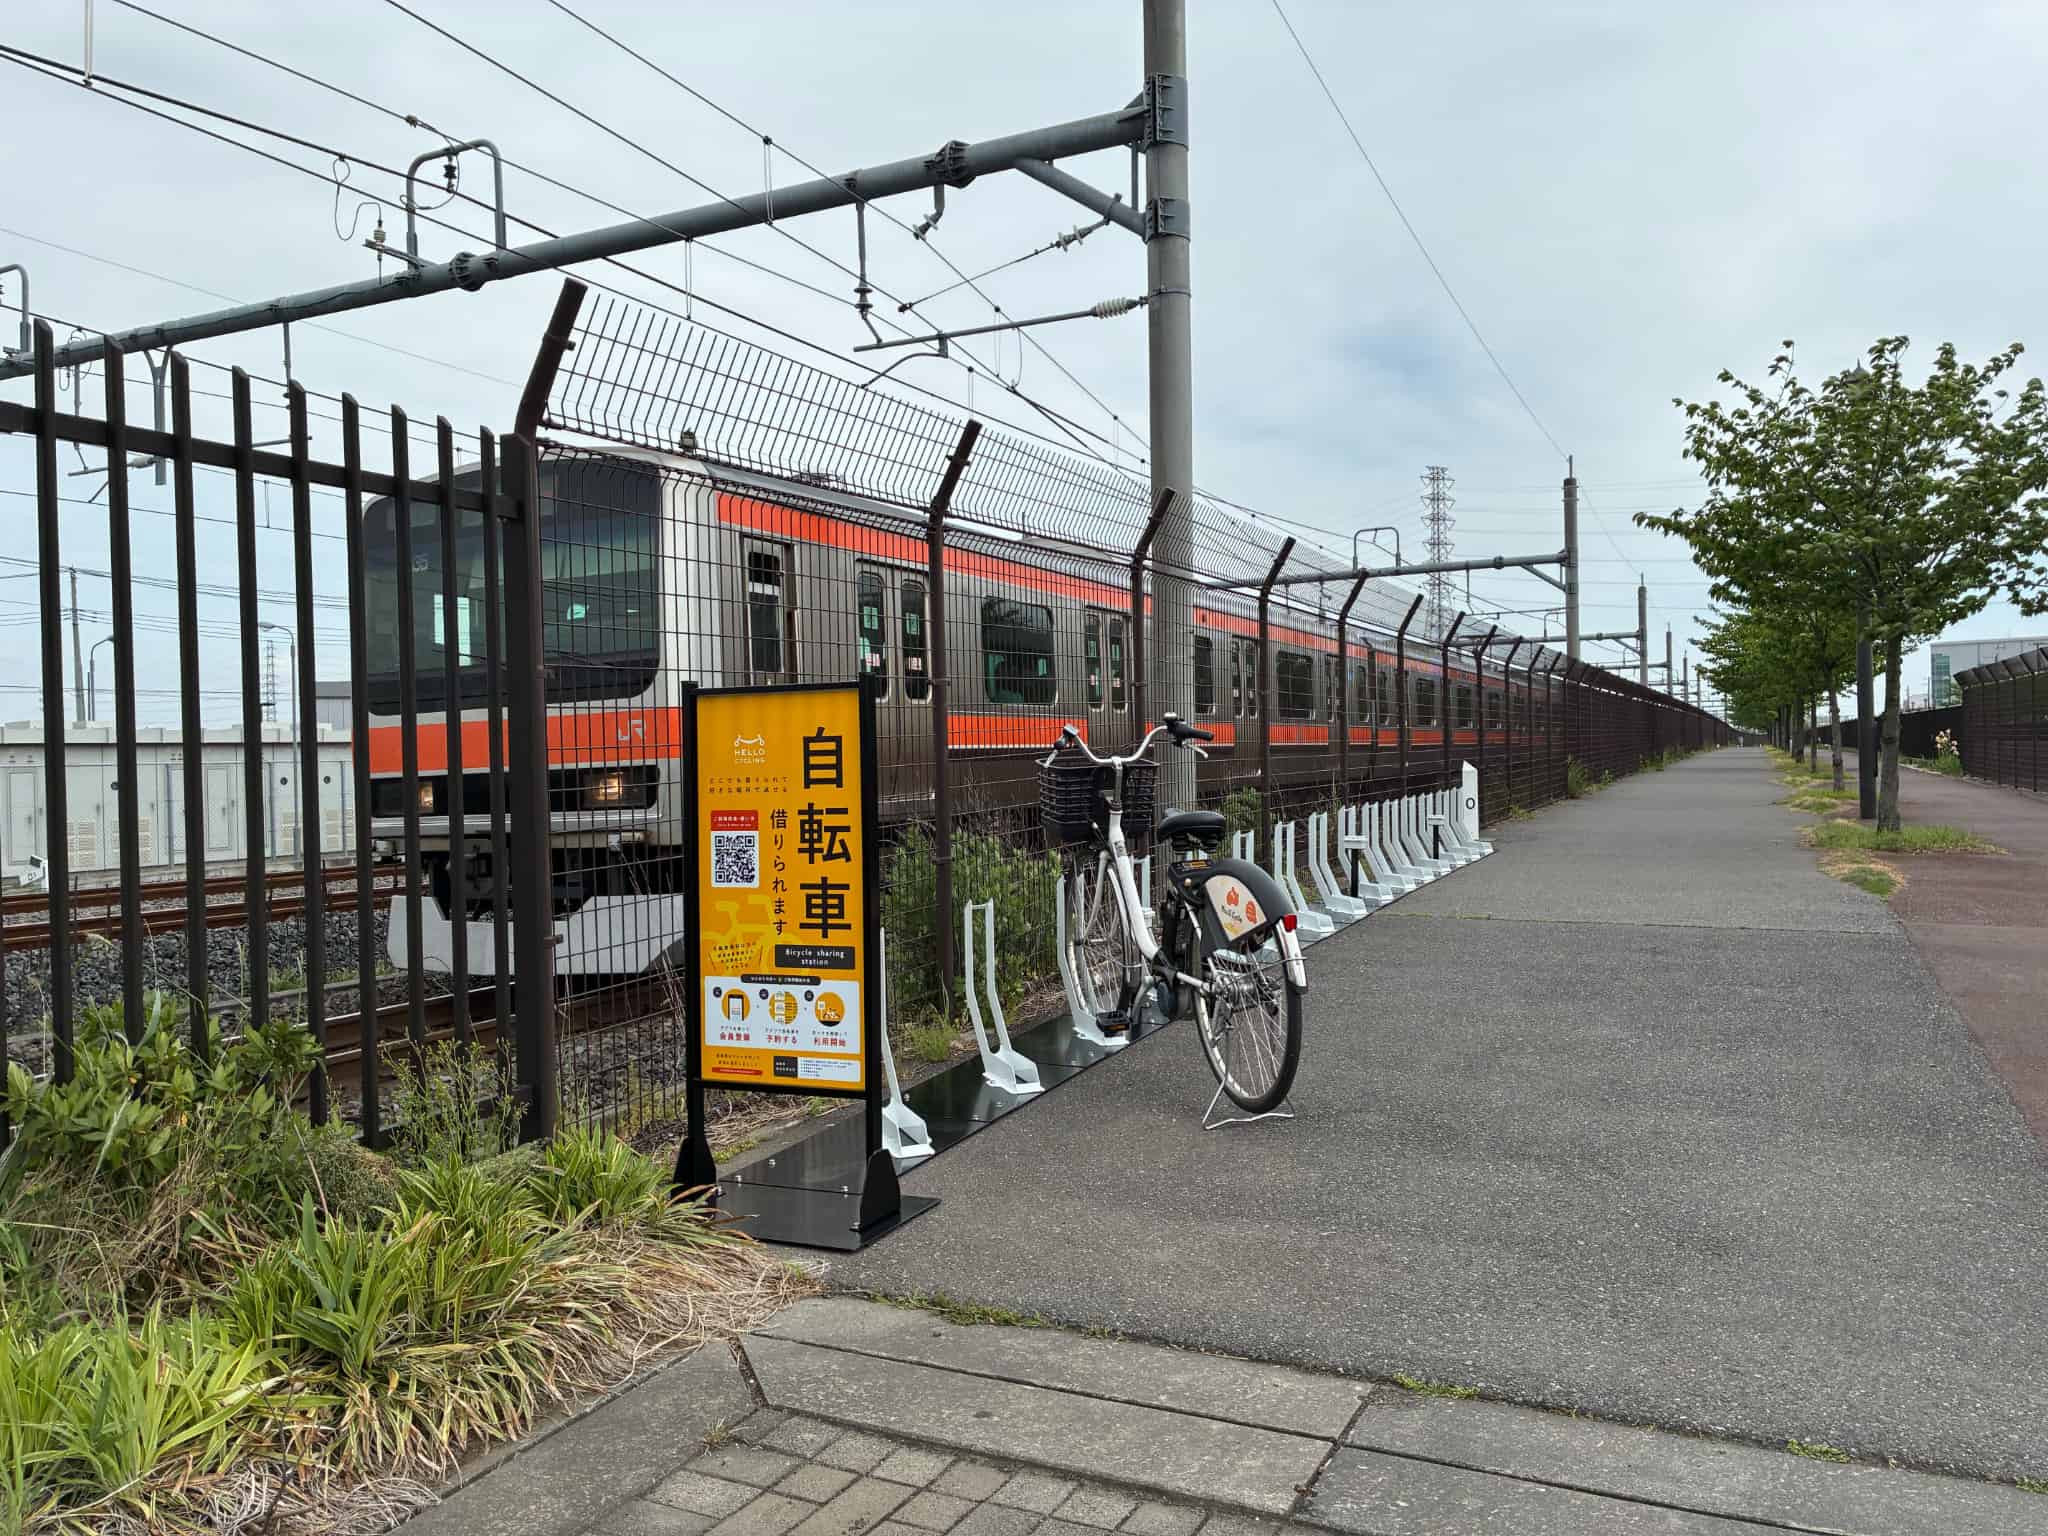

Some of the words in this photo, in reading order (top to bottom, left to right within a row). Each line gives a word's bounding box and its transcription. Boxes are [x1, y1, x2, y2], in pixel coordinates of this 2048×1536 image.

[618, 720, 646, 741] JR
[735, 748, 766, 756] HELLO
[798, 727, 852, 938] 自転車
[770, 809, 788, 935] 借りられます
[785, 948, 812, 957] Bicycle
[816, 949, 845, 959] sharing
